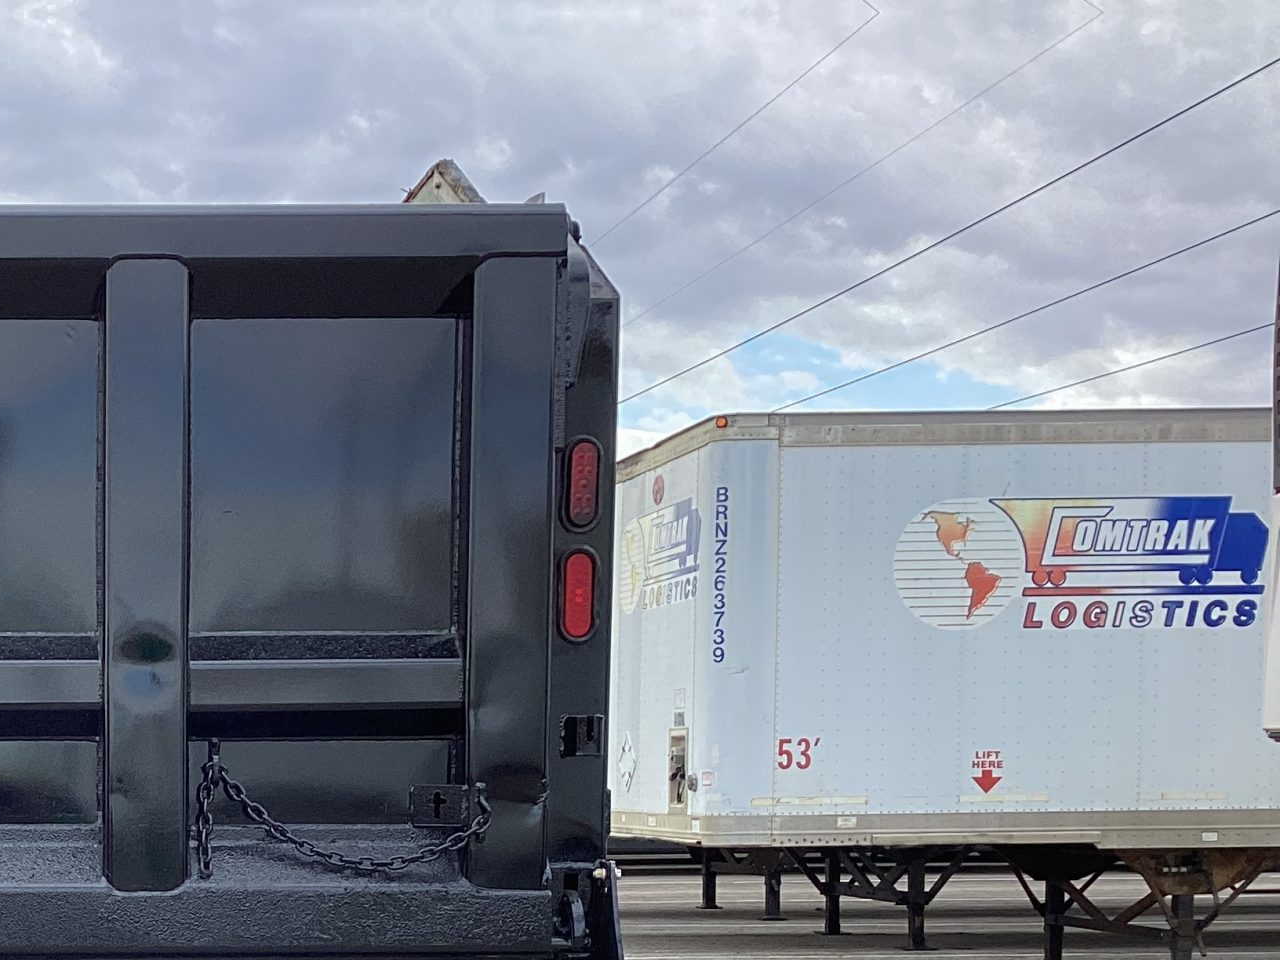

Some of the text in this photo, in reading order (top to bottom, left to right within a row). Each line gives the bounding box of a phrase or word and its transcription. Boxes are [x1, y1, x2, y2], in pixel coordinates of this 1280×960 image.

[1040, 505, 1217, 566] COMTRAK
[712, 486, 729, 664] BRNZ263739
[642, 575, 698, 610] LOGISTICS
[1022, 599, 1258, 629] LOGISTICS
[777, 736, 821, 770] 53'
[972, 760, 1004, 769] HERE
[975, 750, 1001, 760] LIFT
